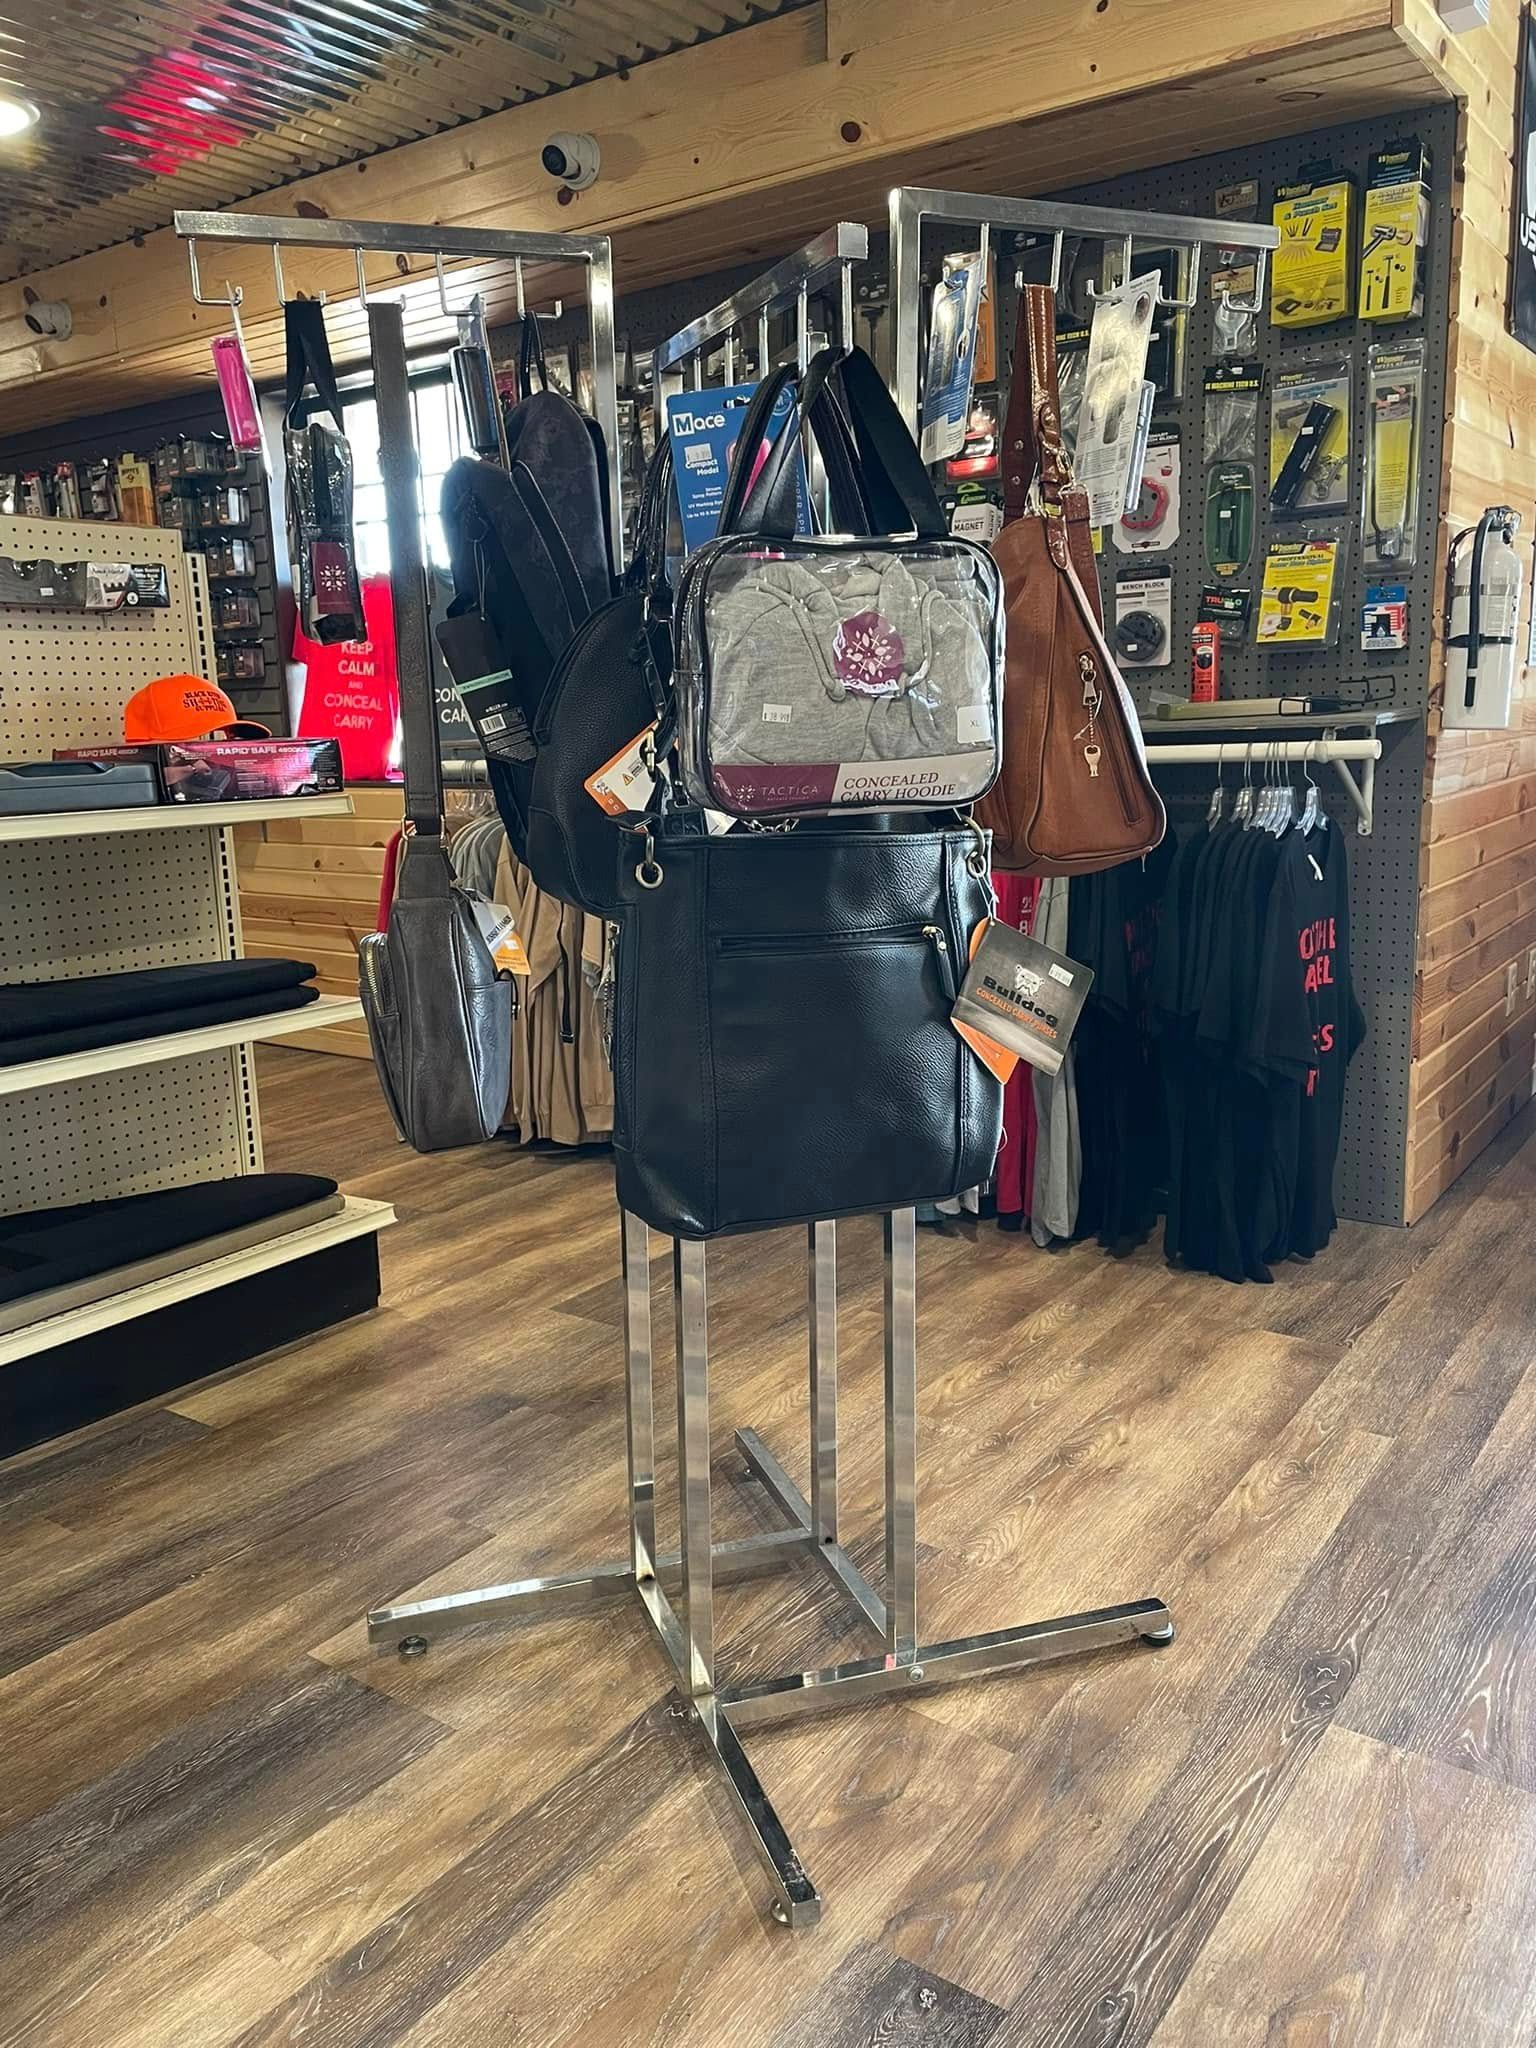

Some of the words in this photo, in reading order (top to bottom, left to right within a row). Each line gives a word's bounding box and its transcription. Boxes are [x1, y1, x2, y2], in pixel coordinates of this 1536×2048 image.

[672, 412, 726, 437] Mace
[686, 458, 718, 469] Compact
[696, 466, 719, 476] Model
[953, 521, 985, 532] MAGNET
[1122, 583, 1144, 591] BENCH
[1144, 581, 1165, 589] BLOCK
[341, 641, 374, 656] KEEP
[337, 660, 375, 677] CALM
[348, 681, 363, 689] AND
[323, 693, 383, 711] CONCEAL
[333, 713, 374, 730] CARRY
[969, 719, 980, 727] XL
[100, 748, 118, 756] SAFE
[216, 746, 249, 756] RAPID
[251, 745, 277, 754] SAFE
[844, 772, 940, 790] CONCEALED
[761, 784, 819, 796] TACTICA
[840, 789, 892, 802] CARRY
[895, 783, 957, 799] HOODIE
[975, 987, 1012, 1014] CONCEALED
[982, 975, 1059, 1029] Bulldog
